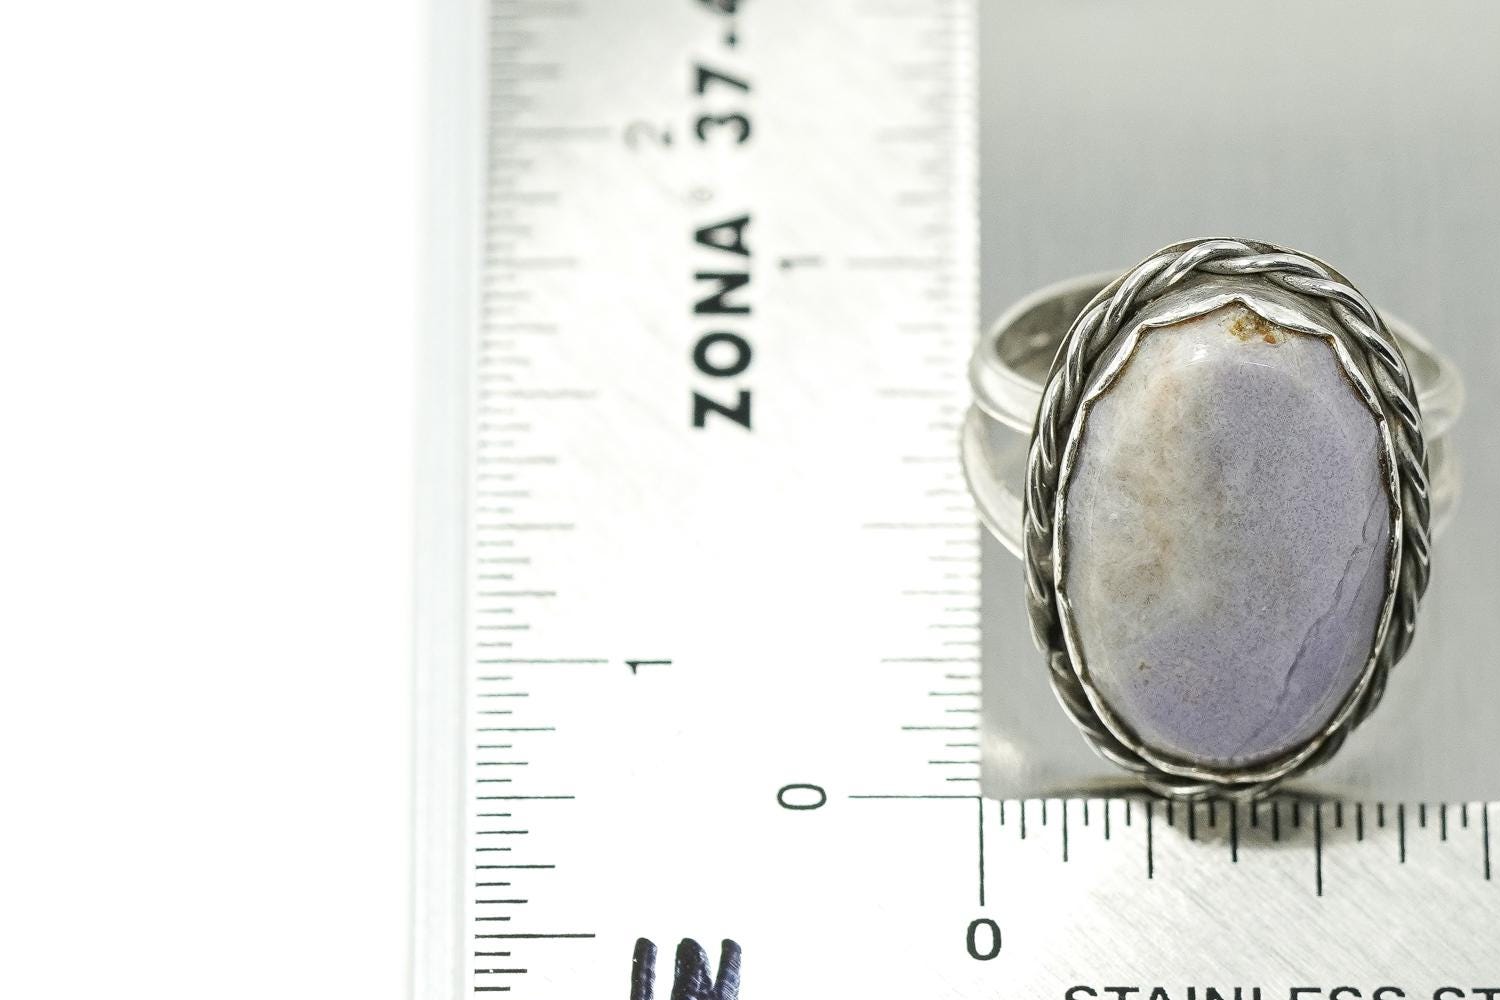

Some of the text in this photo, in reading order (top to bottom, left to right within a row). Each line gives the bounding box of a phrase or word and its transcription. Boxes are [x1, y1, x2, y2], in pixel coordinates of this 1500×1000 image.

[623, 120, 674, 150] 2
[692, 0, 752, 432] ZONA 37-
[778, 254, 824, 271] 1
[624, 658, 673, 675] 1
[776, 782, 827, 811] 0
[965, 917, 1002, 961] 0
